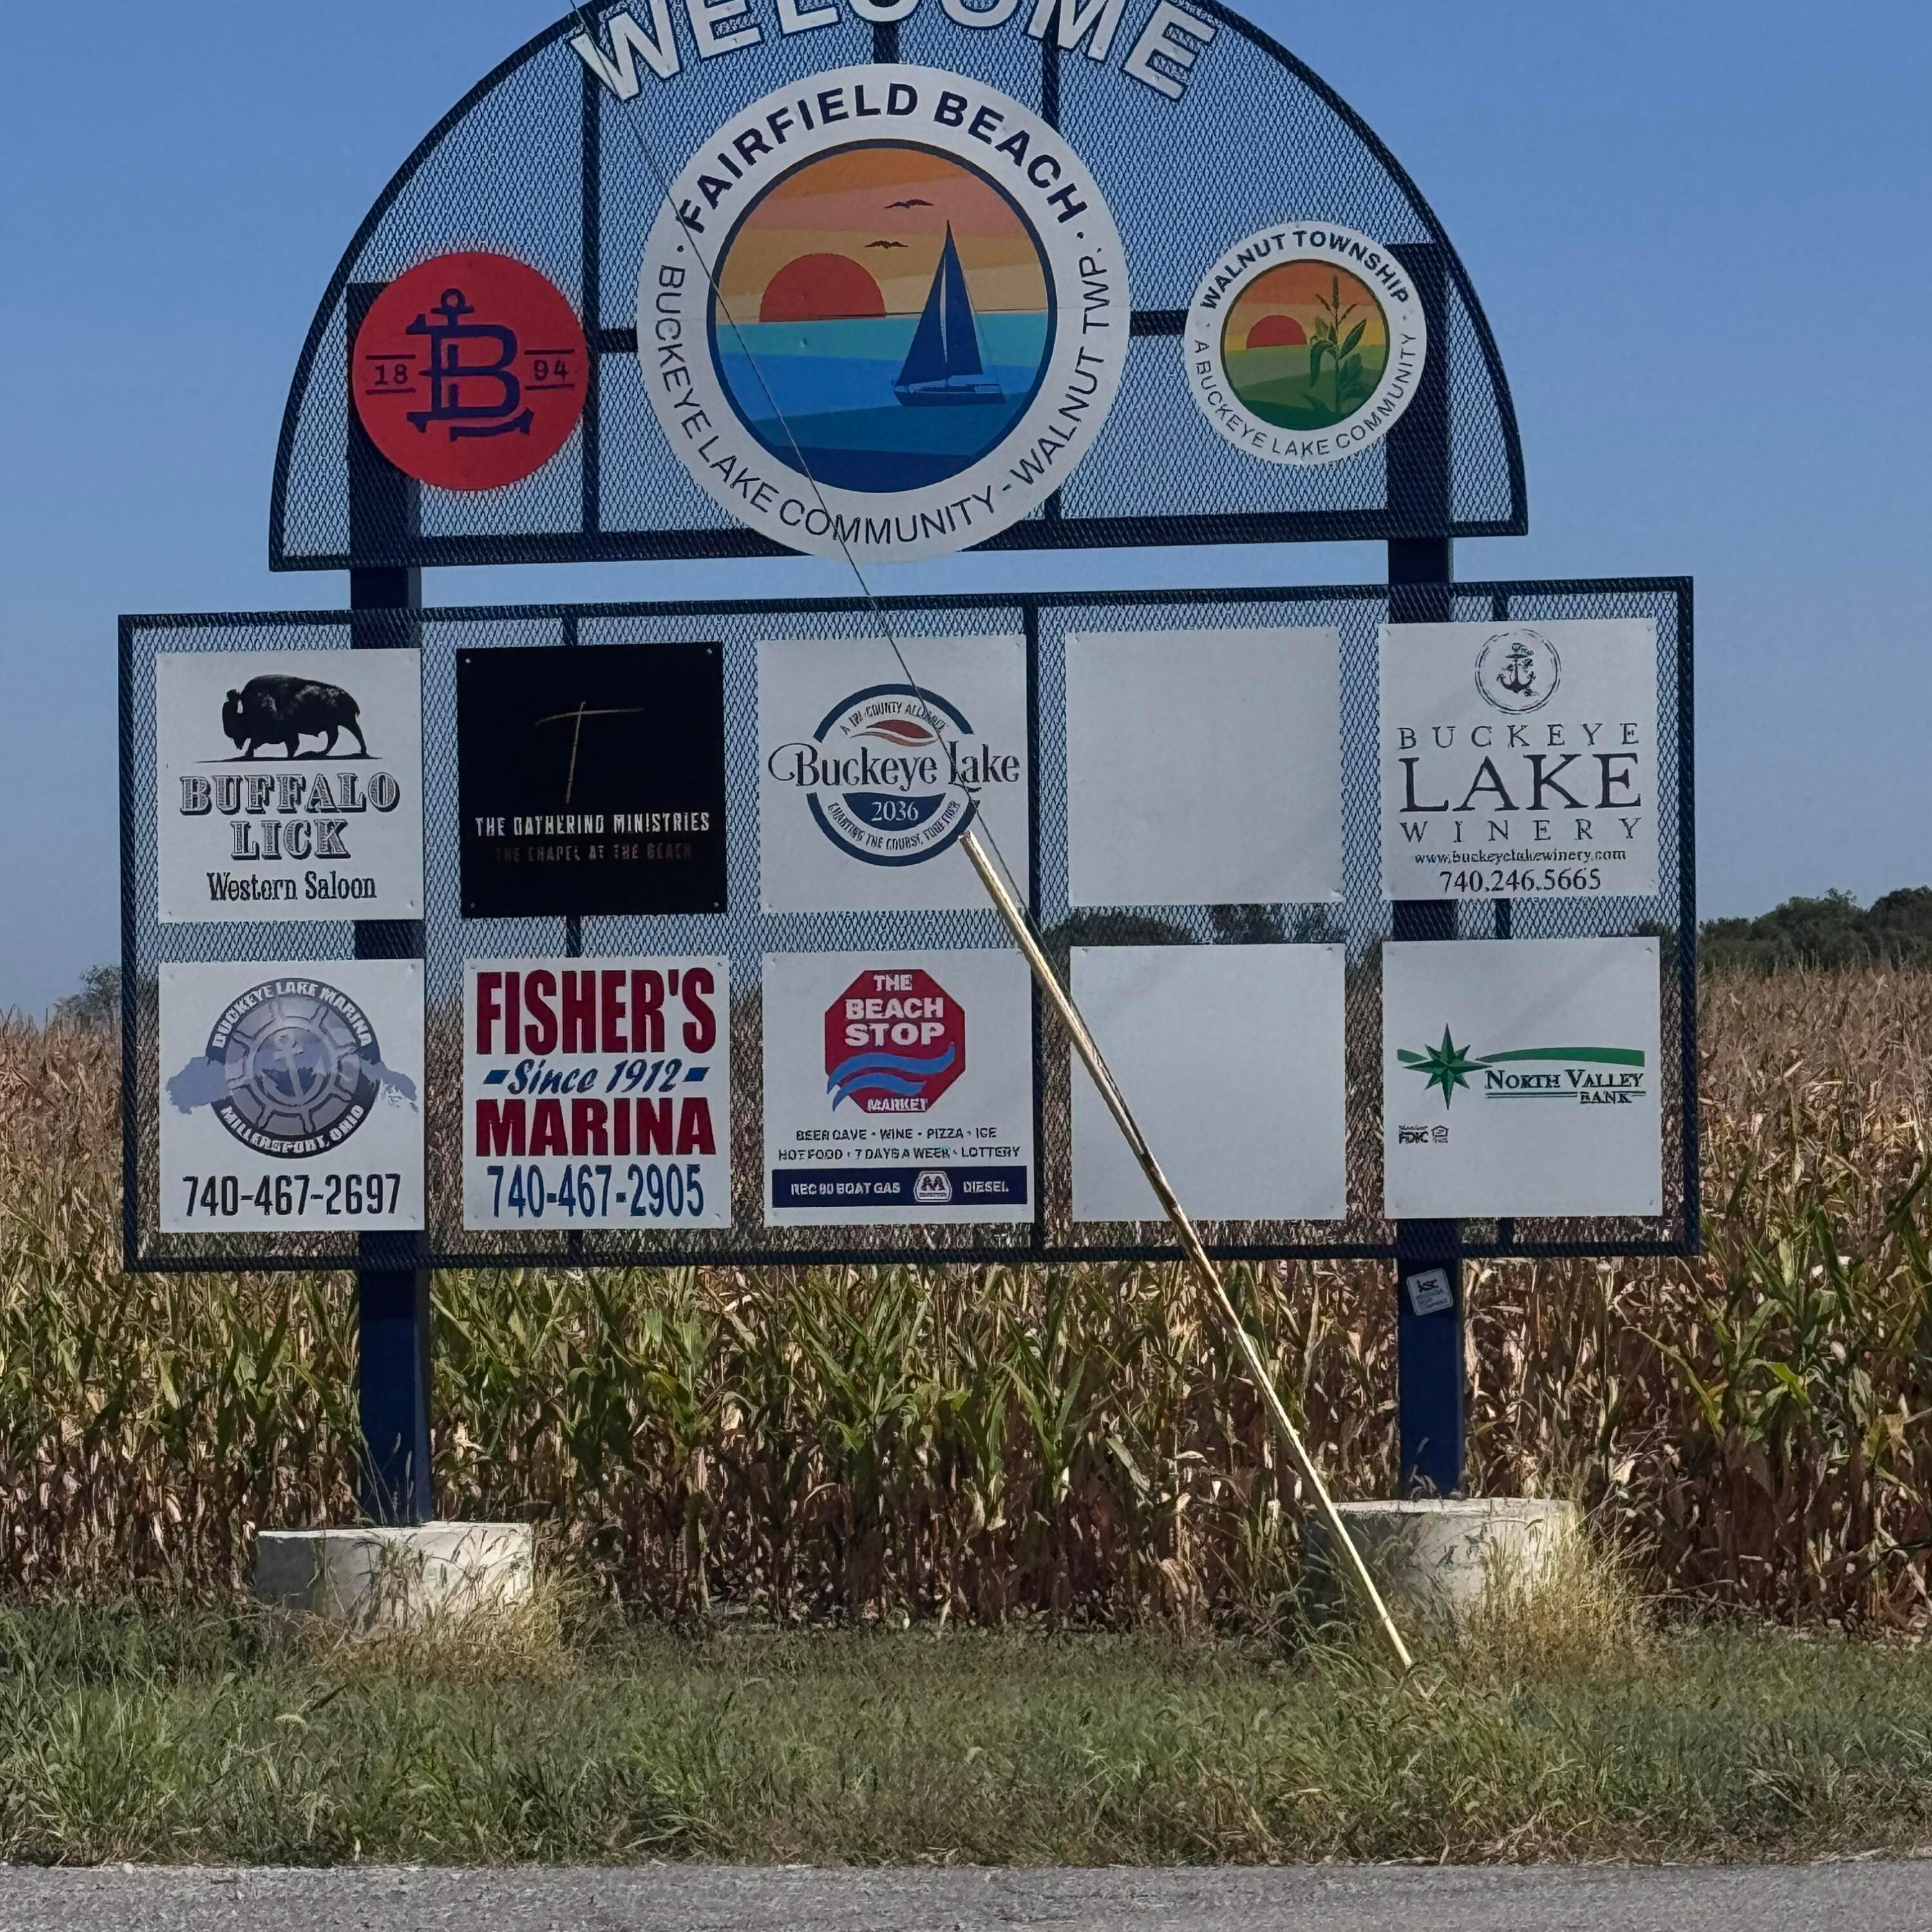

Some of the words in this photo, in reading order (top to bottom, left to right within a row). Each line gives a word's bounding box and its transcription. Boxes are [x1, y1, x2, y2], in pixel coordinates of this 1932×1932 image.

[568, 0, 1219, 102] WELME
[680, 82, 918, 233] FAIRFIELD
[933, 90, 1088, 223] BEACH
[1200, 232, 1285, 310] WALNUT
[1292, 230, 1409, 303] TOWNSHIP
[1195, 339, 1209, 354] A
[374, 364, 409, 386] 18
[533, 359, 569, 381] 94
[655, 264, 712, 440] BUCKEYE
[699, 435, 779, 513] LAKE
[779, 485, 994, 545] COMMUNITY
[1010, 346, 1104, 486] WALNUT
[1195, 359, 1267, 448] BUCKEYE
[1335, 332, 1417, 449] COMMUNITY
[1272, 437, 1330, 457] LAKE
[1397, 722, 1640, 750] BUCKEYE
[768, 742, 938, 792] Buckeye
[947, 740, 1021, 793] Lake
[179, 772, 401, 816] BUFFALO
[1397, 752, 1642, 813] LAKE
[475, 817, 506, 837] THE
[613, 812, 710, 833] MINISTRIES
[871, 800, 919, 822] 2036
[230, 819, 352, 860] LICK
[1399, 817, 1642, 843] WINERY
[495, 846, 521, 863] THE
[528, 845, 581, 862] CHAPEL
[588, 844, 605, 860] AT
[613, 843, 639, 860] THE
[647, 842, 692, 860] BEACH
[1414, 848, 1627, 865] www.buckeyelakewinery.com
[206, 871, 297, 902] Western
[305, 870, 377, 899] Saloon
[1439, 867, 1602, 893] 740.246.5665
[873, 974, 913, 991] THE
[276, 981, 319, 996] LAKE
[319, 987, 373, 1047] MARINA
[476, 967, 717, 1056] FISHER'S
[845, 997, 944, 1019] BEACH
[844, 1022, 945, 1047] STOP
[507, 1058, 598, 1095] Since
[605, 1057, 683, 1094] 1912
[1579, 1090, 1633, 1104] BANK
[475, 1097, 717, 1157] MARINA
[796, 1130, 829, 1141] BEER
[832, 1129, 867, 1141] CAVE
[880, 1128, 914, 1141] WINE
[927, 1128, 964, 1139] PIZZA
[976, 1127, 998, 1139] ICE
[778, 1149, 806, 1160] HOT
[808, 1148, 843, 1160] FOOD
[855, 1148, 862, 1160] 7
[866, 1148, 900, 1159] DAYS
[902, 1147, 911, 1159] A
[913, 1146, 951, 1159] WEEK
[961, 1146, 1021, 1159] LOTTERY
[182, 1173, 401, 1217] 740-467-2697
[486, 1163, 705, 1218] 740-467-2905
[836, 1182, 871, 1195] BOAT
[873, 1182, 901, 1194] GAS
[963, 1180, 1009, 1193] DIESEL
